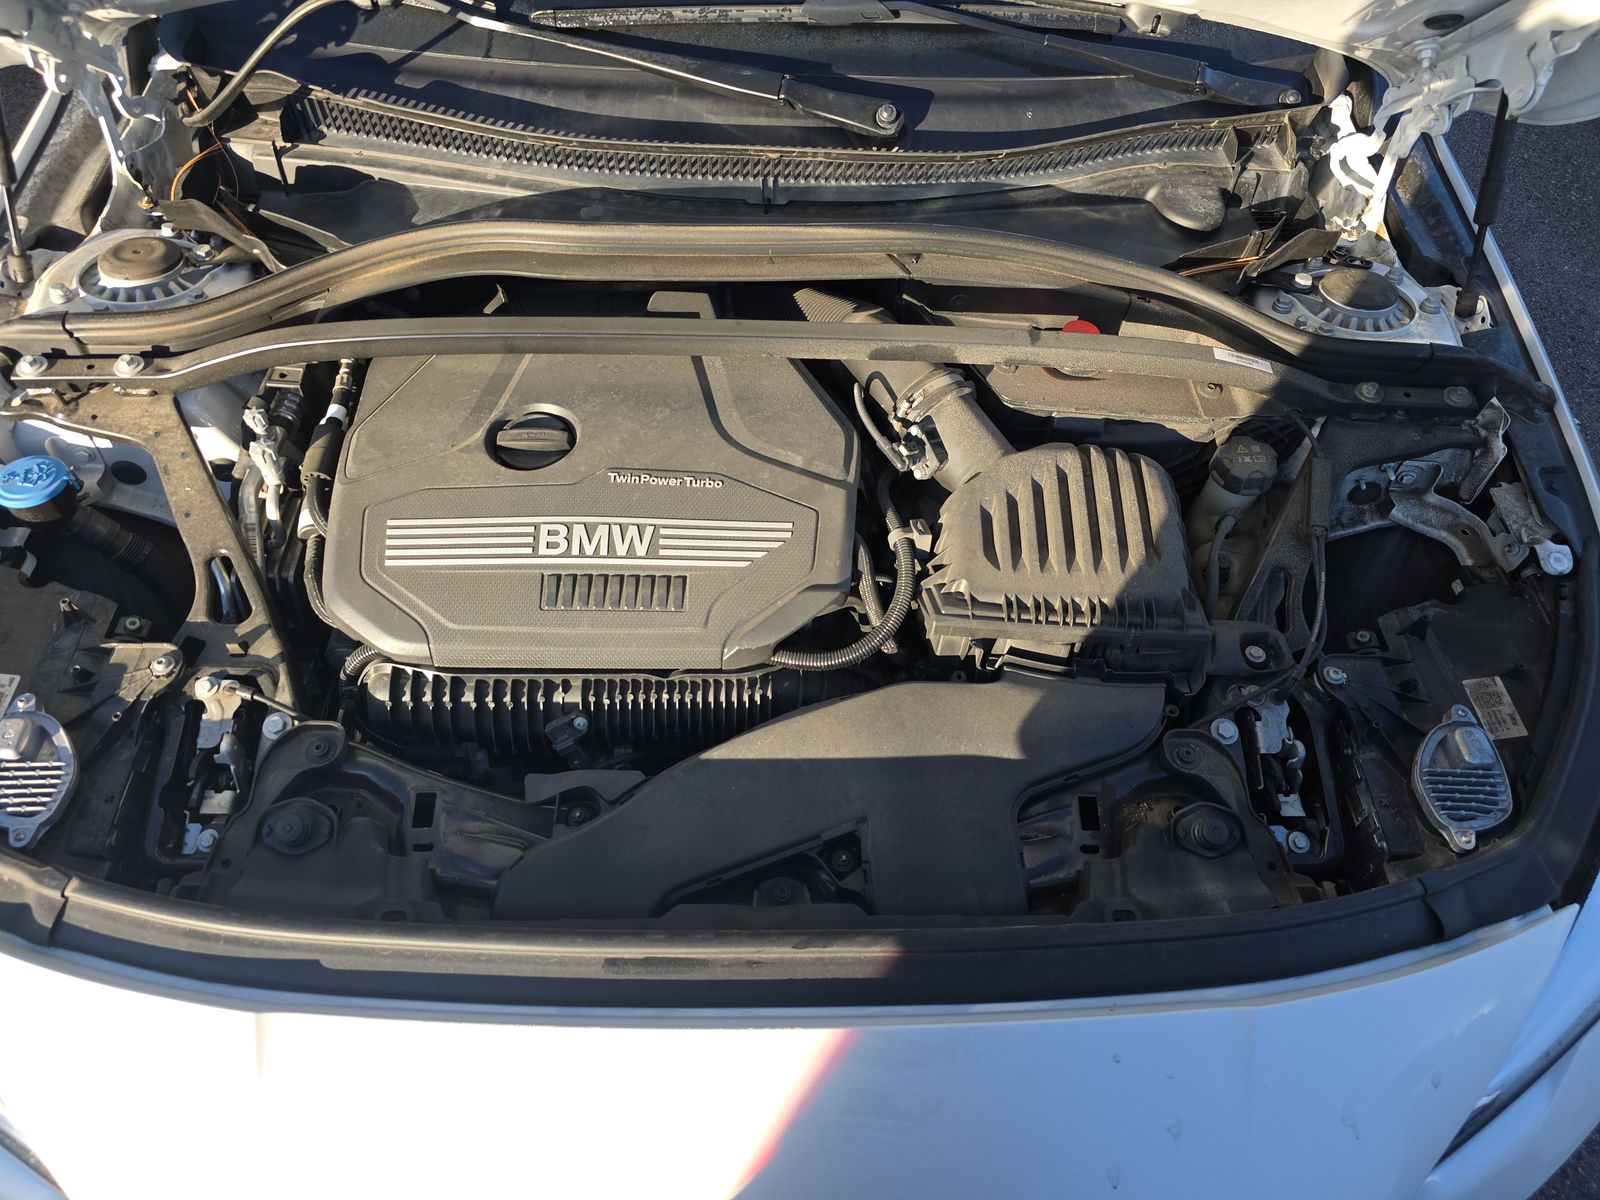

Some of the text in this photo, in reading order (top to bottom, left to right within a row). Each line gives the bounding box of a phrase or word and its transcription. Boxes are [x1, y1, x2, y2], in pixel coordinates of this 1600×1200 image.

[608, 472, 723, 488] TwinPower Turbo
[538, 522, 656, 557] BMW
